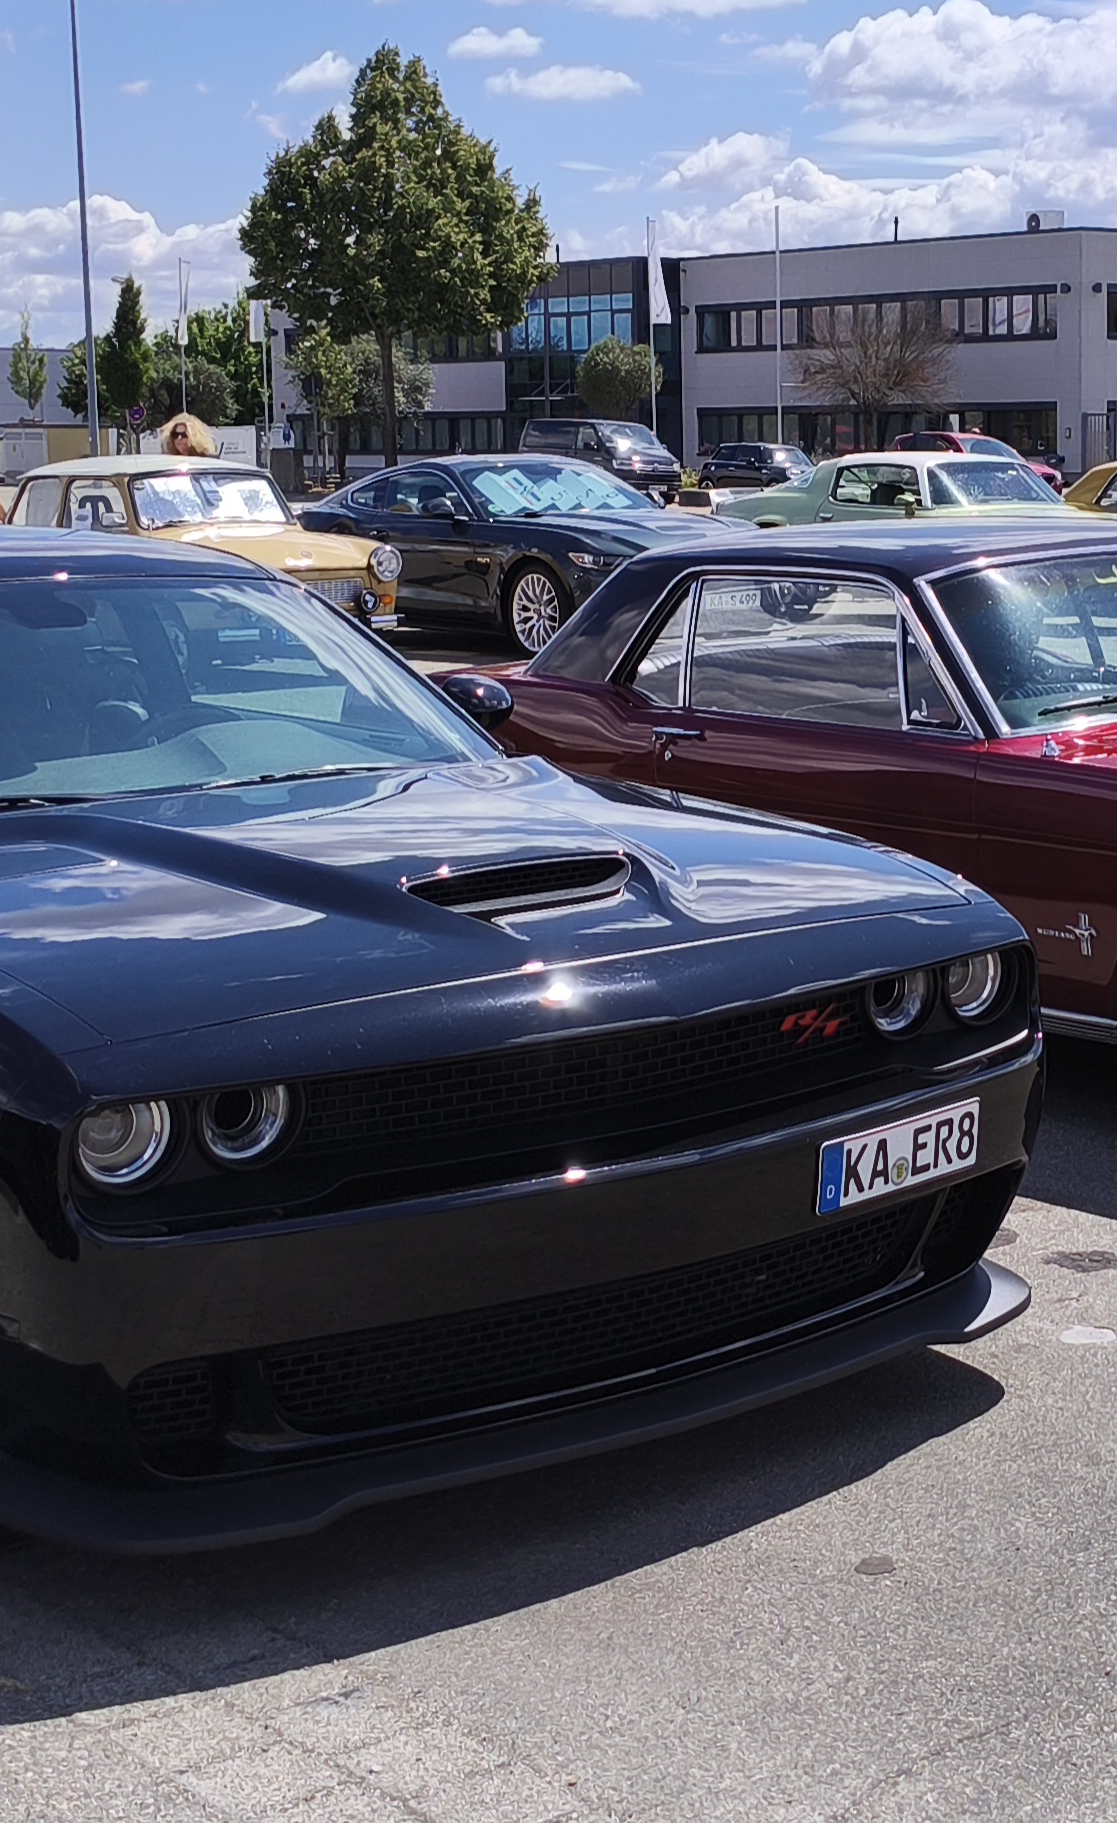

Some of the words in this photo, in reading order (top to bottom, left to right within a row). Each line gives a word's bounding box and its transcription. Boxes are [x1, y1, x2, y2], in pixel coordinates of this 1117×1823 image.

[709, 595, 724, 607] KA
[780, 1003, 849, 1045] R/T
[843, 1138, 890, 1198] KA
[911, 1111, 975, 1177] ER8
[826, 1185, 835, 1199] D
